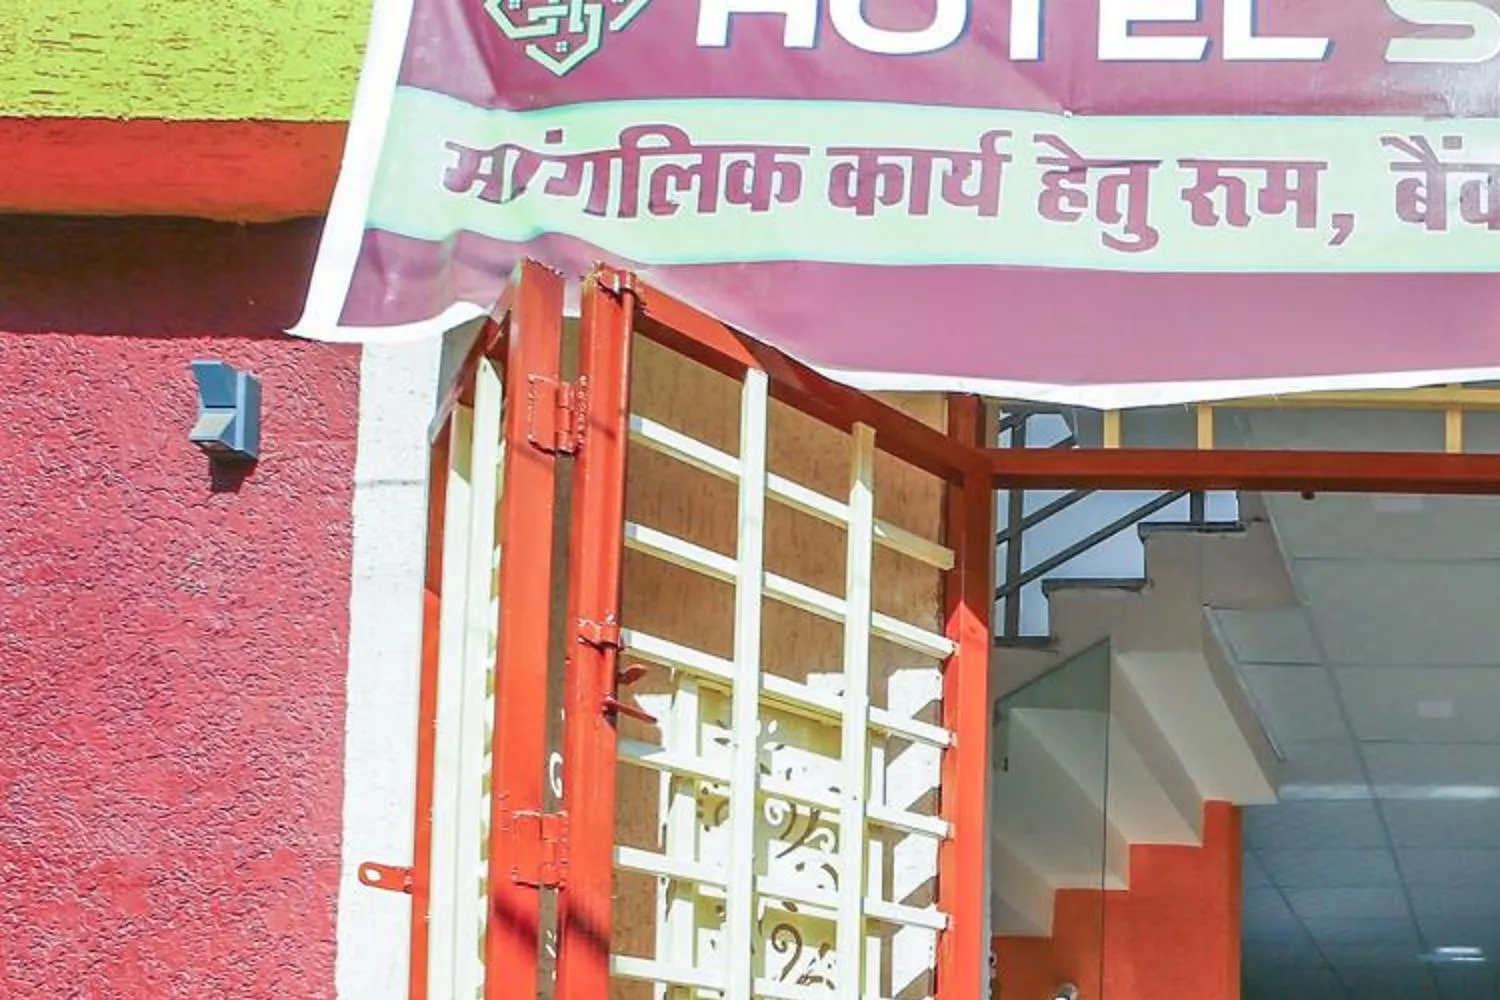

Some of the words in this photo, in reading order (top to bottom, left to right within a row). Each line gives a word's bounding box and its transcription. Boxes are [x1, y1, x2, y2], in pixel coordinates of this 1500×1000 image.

[443, 124, 810, 218] मांगलिक
[826, 130, 1012, 217] कार्य
[1033, 133, 1163, 252] हेतु
